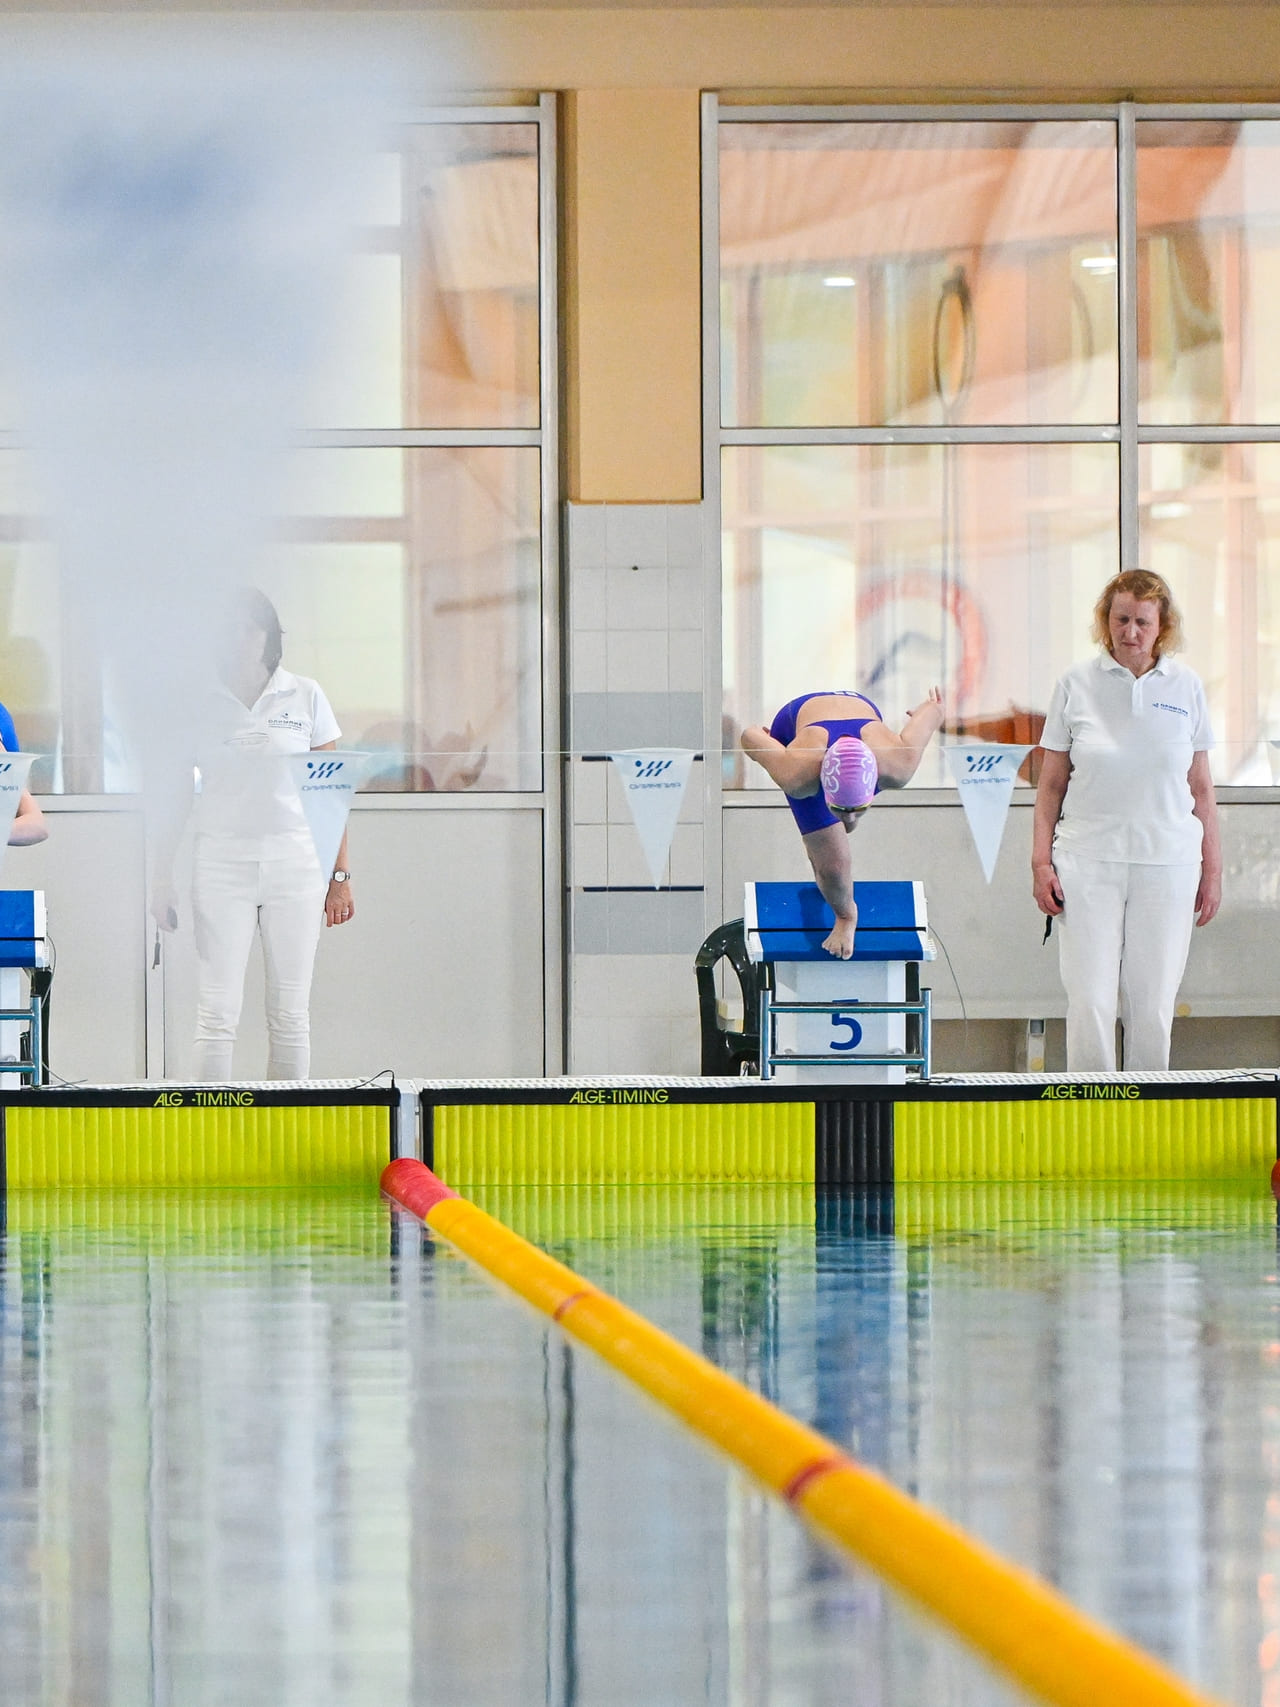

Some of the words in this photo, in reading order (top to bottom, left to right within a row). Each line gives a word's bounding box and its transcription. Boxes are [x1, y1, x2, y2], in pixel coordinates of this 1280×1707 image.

[830, 999, 863, 1050] 5
[153, 1092, 255, 1107] ALG-TIMING
[569, 1089, 669, 1103] ALGE-TIMING
[1040, 1085, 1141, 1100] ALGE-TIMING
